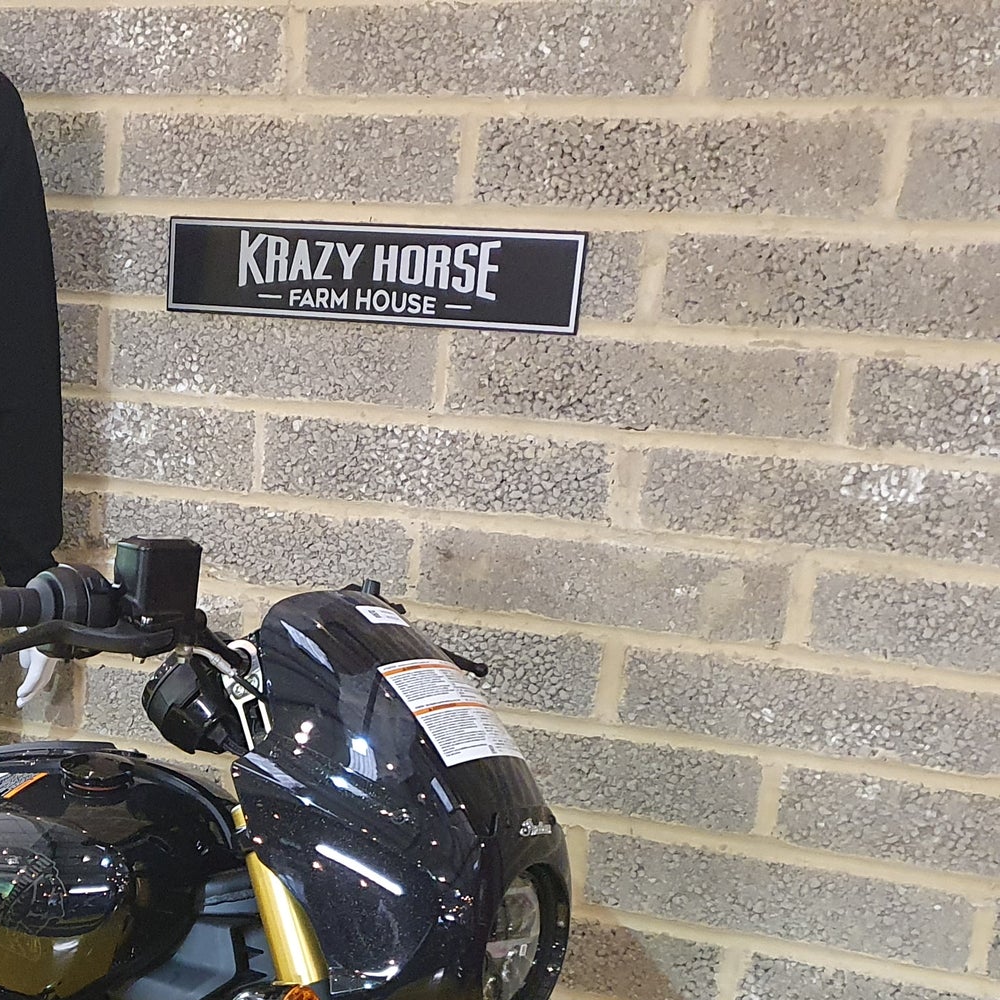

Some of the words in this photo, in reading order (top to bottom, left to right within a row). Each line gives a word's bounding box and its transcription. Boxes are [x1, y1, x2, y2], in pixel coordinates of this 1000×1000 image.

[238, 230, 365, 287] KRAZY
[373, 239, 502, 301] HORSE
[288, 289, 348, 310] FARM
[355, 290, 437, 315] HOUSE
